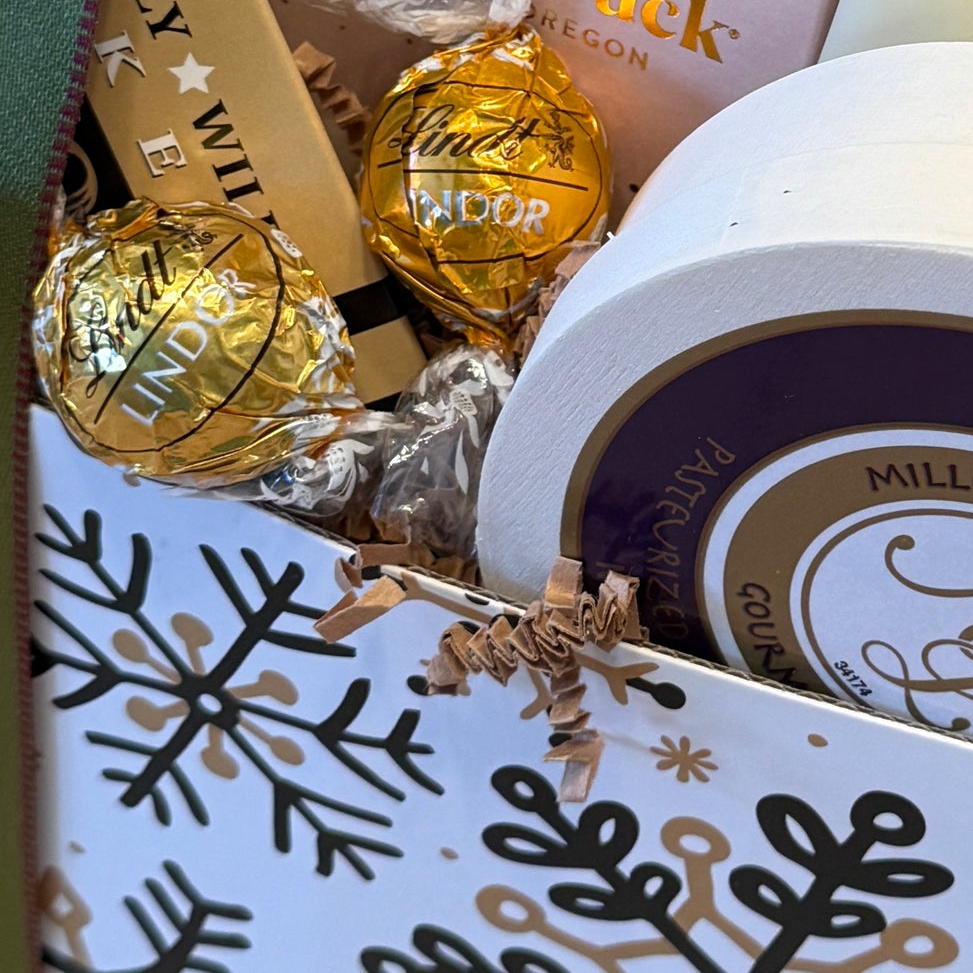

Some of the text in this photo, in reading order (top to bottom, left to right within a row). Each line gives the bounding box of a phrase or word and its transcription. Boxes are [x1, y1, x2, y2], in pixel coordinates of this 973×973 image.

[120, 268, 256, 427] LINDOR
[646, 437, 736, 639] PASTEURIZED
[737, 583, 809, 692] GOURM
[834, 660, 872, 697] 34174
